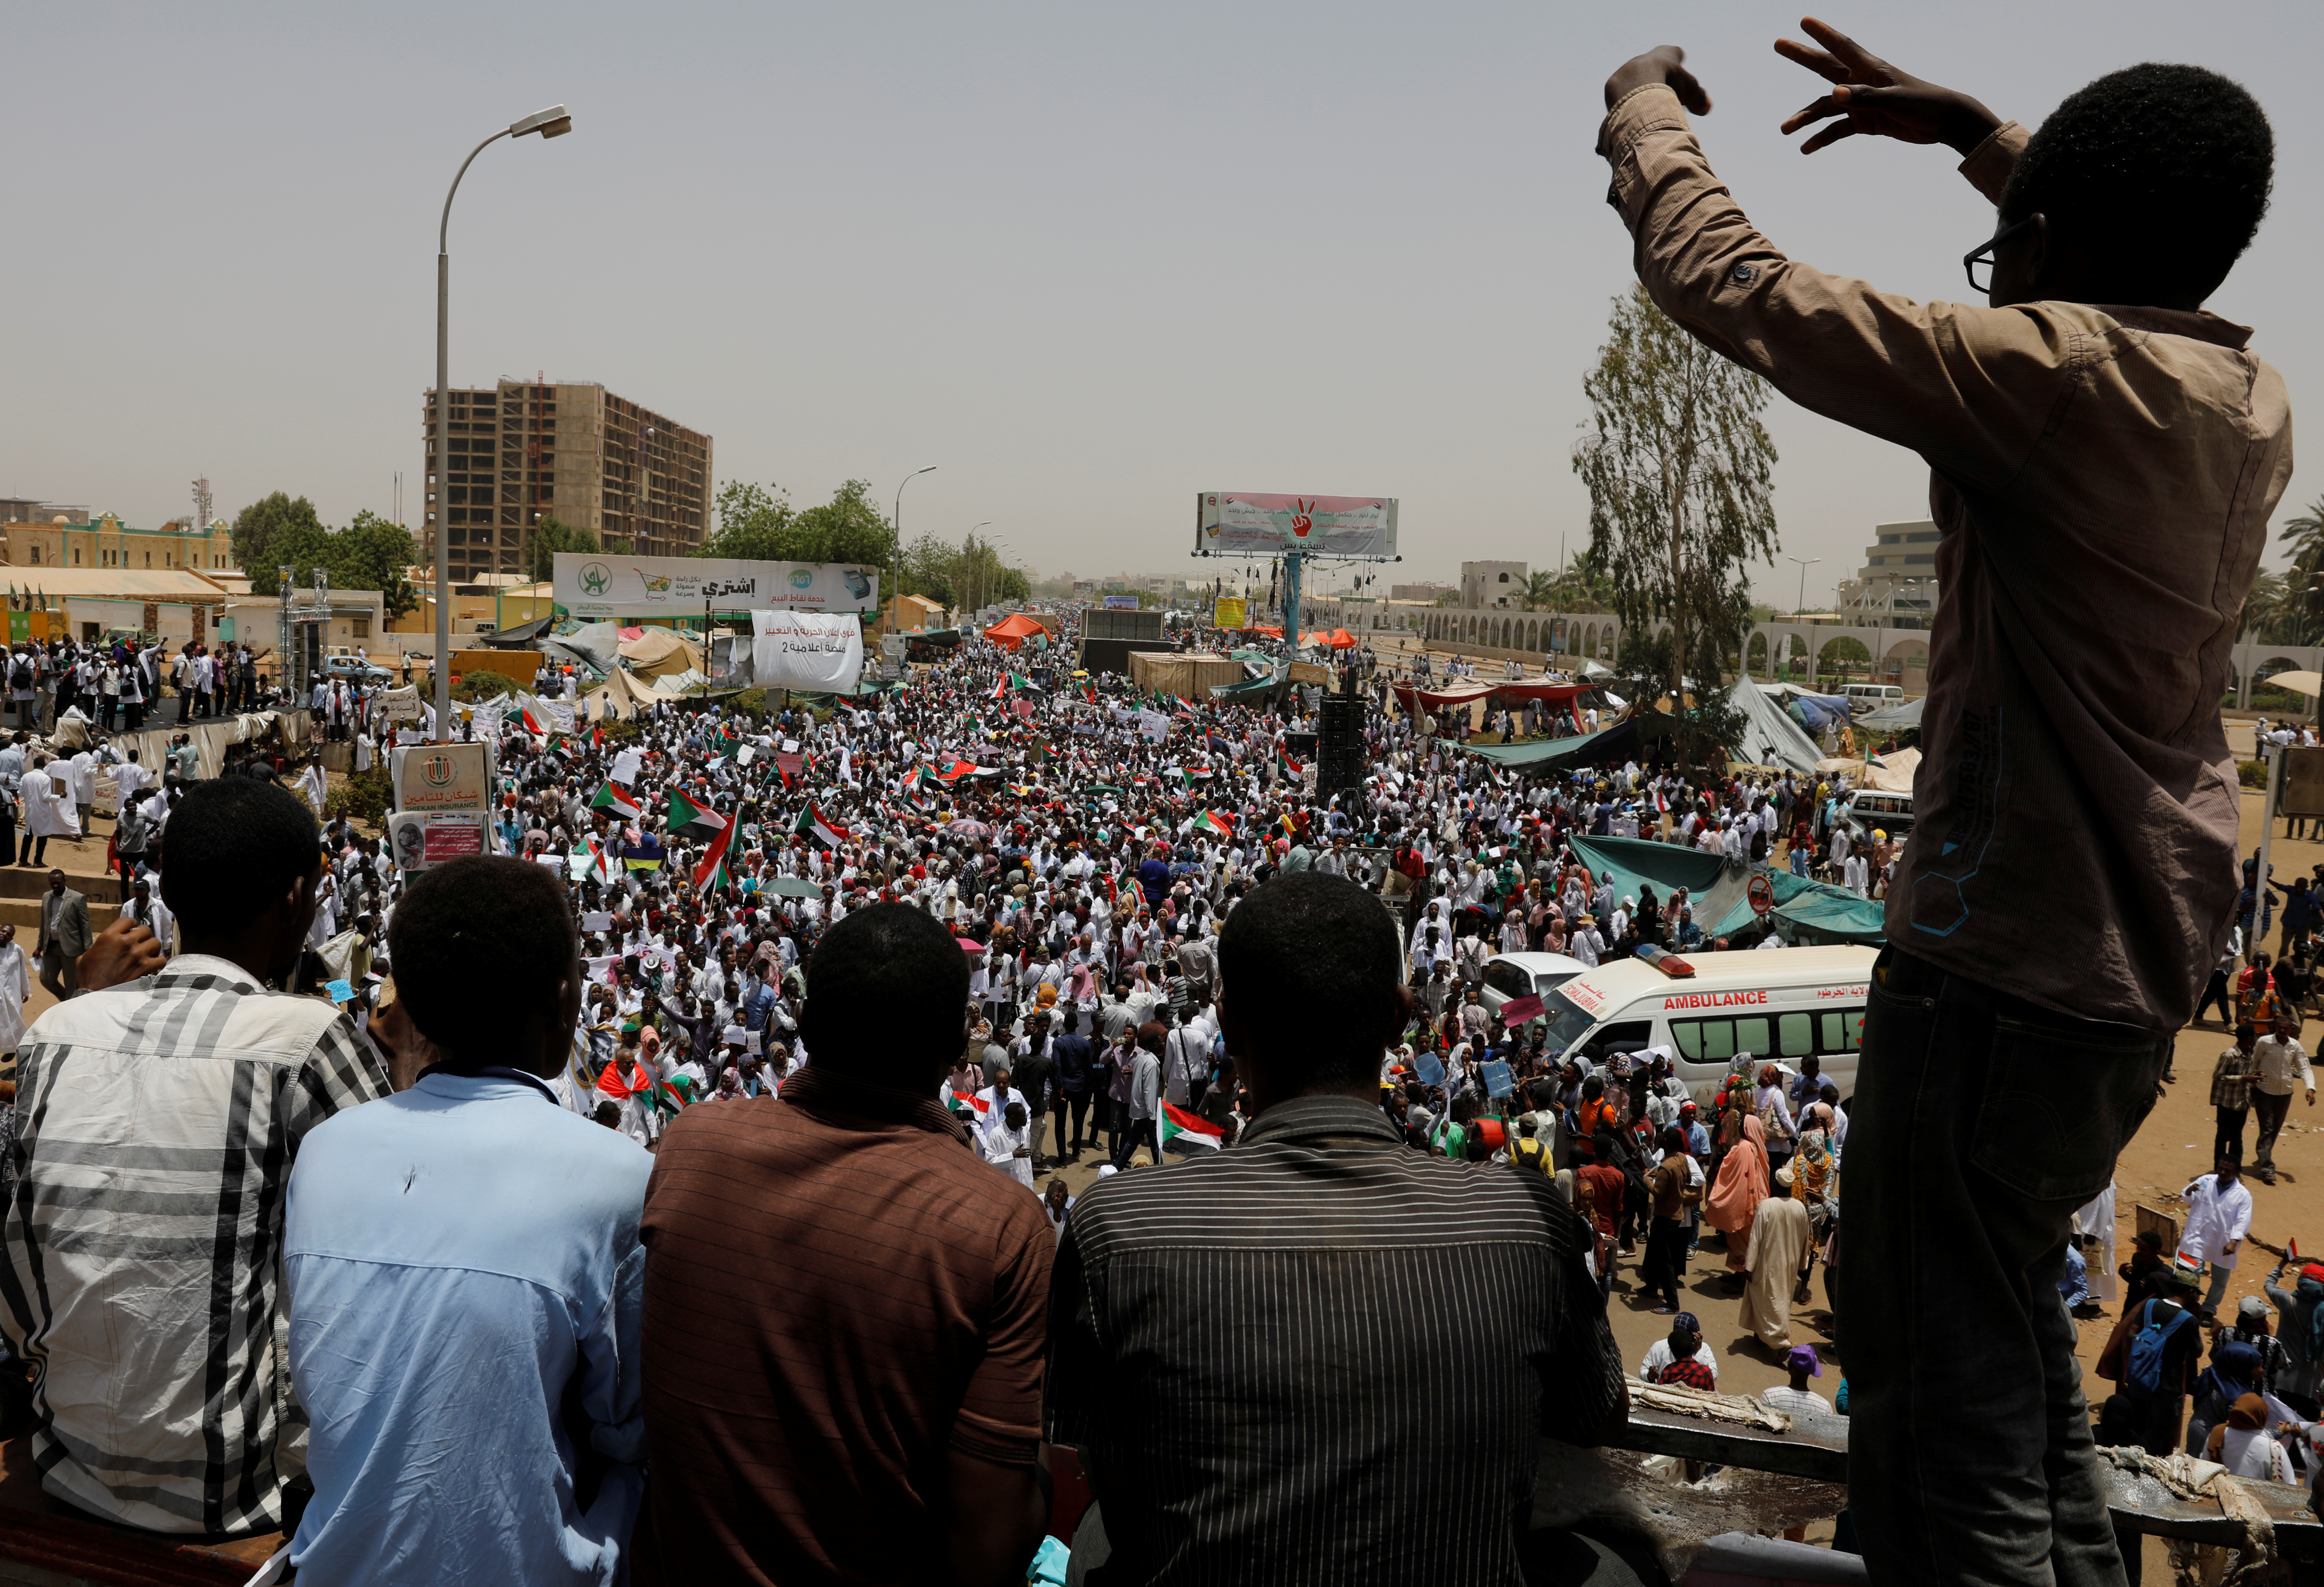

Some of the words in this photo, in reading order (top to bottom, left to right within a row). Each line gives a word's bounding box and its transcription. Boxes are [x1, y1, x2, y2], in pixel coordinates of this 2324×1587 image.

[1299, 541, 1325, 550] تسقط
[676, 589, 694, 597] وسرعة
[702, 578, 755, 599] إشتري
[771, 594, 788, 604] البيع
[765, 626, 791, 636] التغيير
[800, 626, 823, 637] الحرية
[840, 629, 855, 638] قوى
[782, 642, 788, 653] 2
[790, 640, 823, 655] إعلامية
[825, 641, 846, 654] منصة
[404, 792, 444, 805] للتأمين
[445, 790, 478, 802] شيكان
[438, 802, 478, 810] INSURANCE
[1818, 987, 1848, 999] الخرطوم
[1849, 985, 1869, 997] ولاية
[1664, 991, 1767, 1010] AMBULANCE
